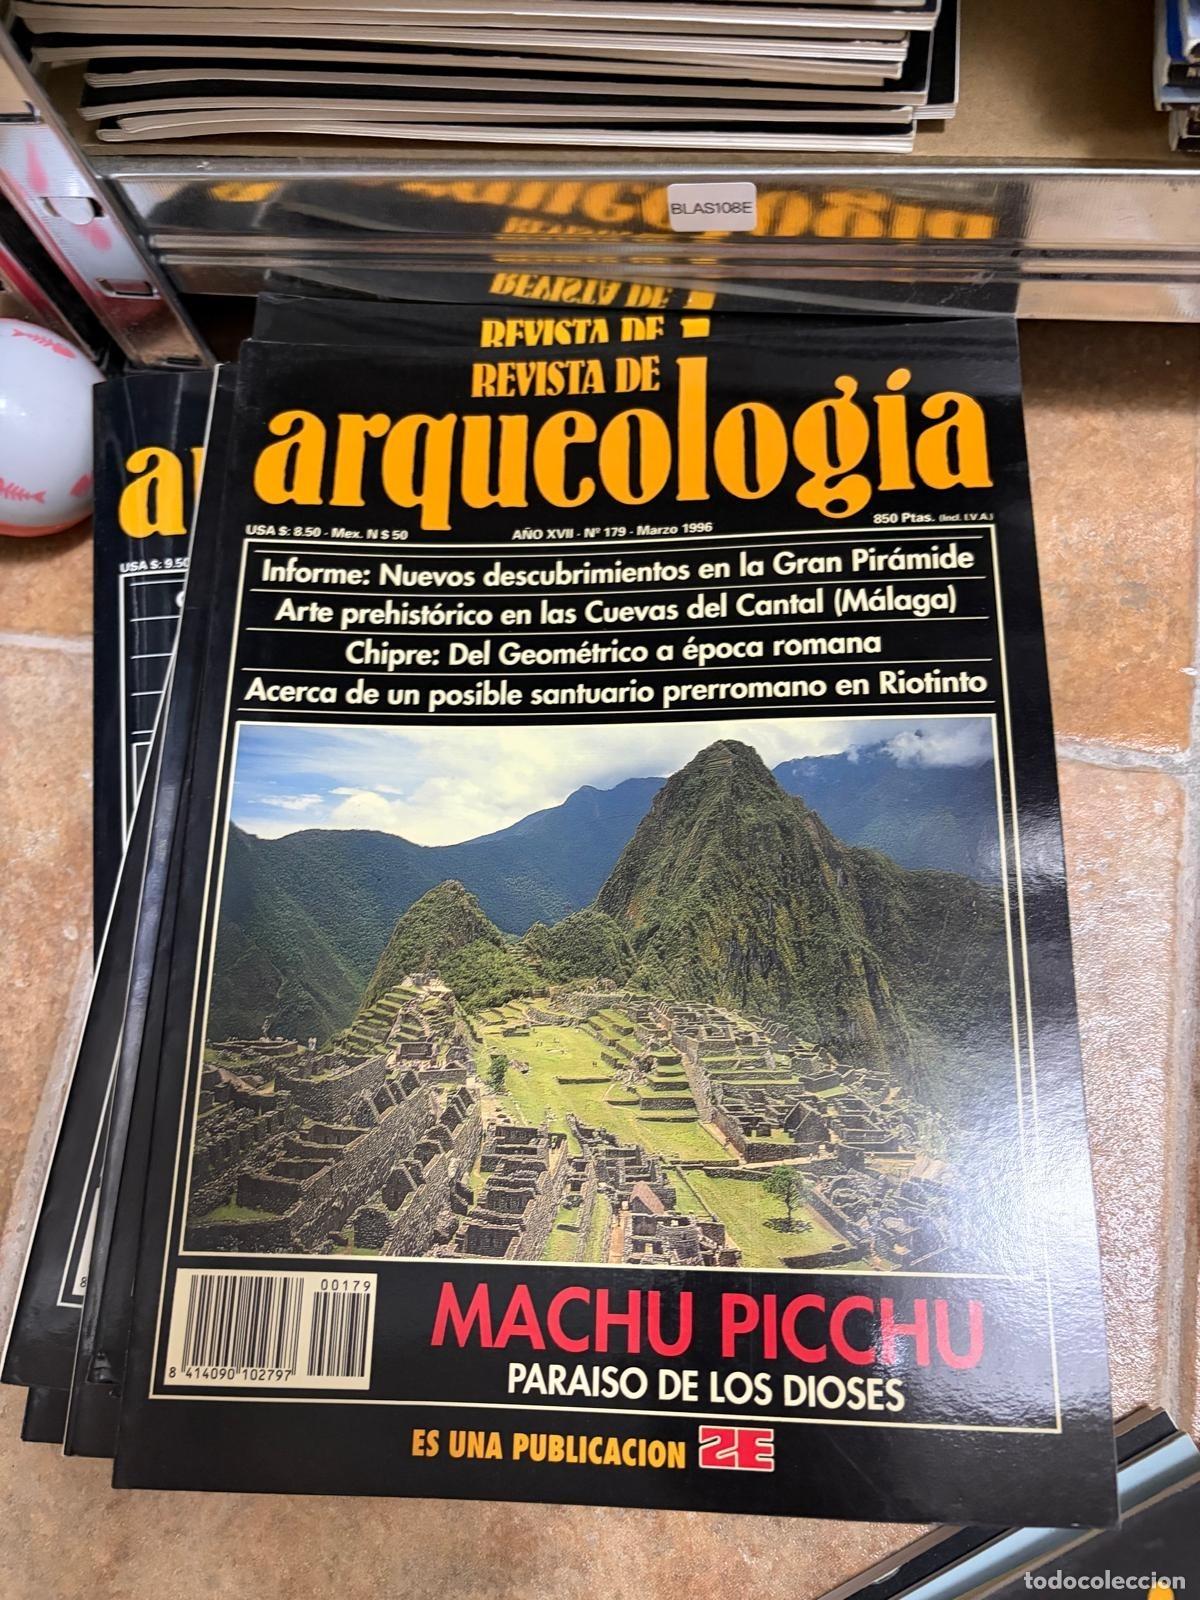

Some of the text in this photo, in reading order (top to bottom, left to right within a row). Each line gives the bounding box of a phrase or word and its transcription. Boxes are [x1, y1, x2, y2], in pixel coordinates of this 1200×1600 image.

[671, 202, 753, 215] BLAS108E
[471, 355, 661, 398] REVISTA DE
[512, 527, 543, 540] AÑO
[546, 528, 574, 540] XVII
[604, 526, 626, 538] 179
[636, 524, 678, 536] Marzo
[682, 522, 713, 533] 1996
[873, 513, 899, 524] 850
[901, 512, 936, 523] Ptas.
[245, 524, 276, 536] USA
[293, 527, 322, 537] 8.50
[330, 528, 364, 539] Mex.
[391, 530, 409, 540] 50
[119, 560, 148, 573] USA
[261, 542, 974, 587] Informe: Nuevos descubrimientos en la Gran Pirámide
[275, 584, 957, 630] Arte prehistórico en las Cuevas del Cantal (Málaga)
[345, 635, 882, 672] Chipre: Del Geométrico a época romana
[244, 668, 988, 713] Acerca de un posible santuario prerromano en Riotinto
[80, 1276, 87, 1288] 8
[321, 1279, 371, 1292] 00179
[430, 1281, 984, 1370] MACHU PICCHU
[169, 1366, 292, 1382] 8 414090 102797
[507, 1362, 905, 1412] PARAISO DE LOS DIOSES
[412, 1429, 440, 1457] ES
[449, 1430, 503, 1459] UNA
[512, 1432, 686, 1469] PUBLICACION
